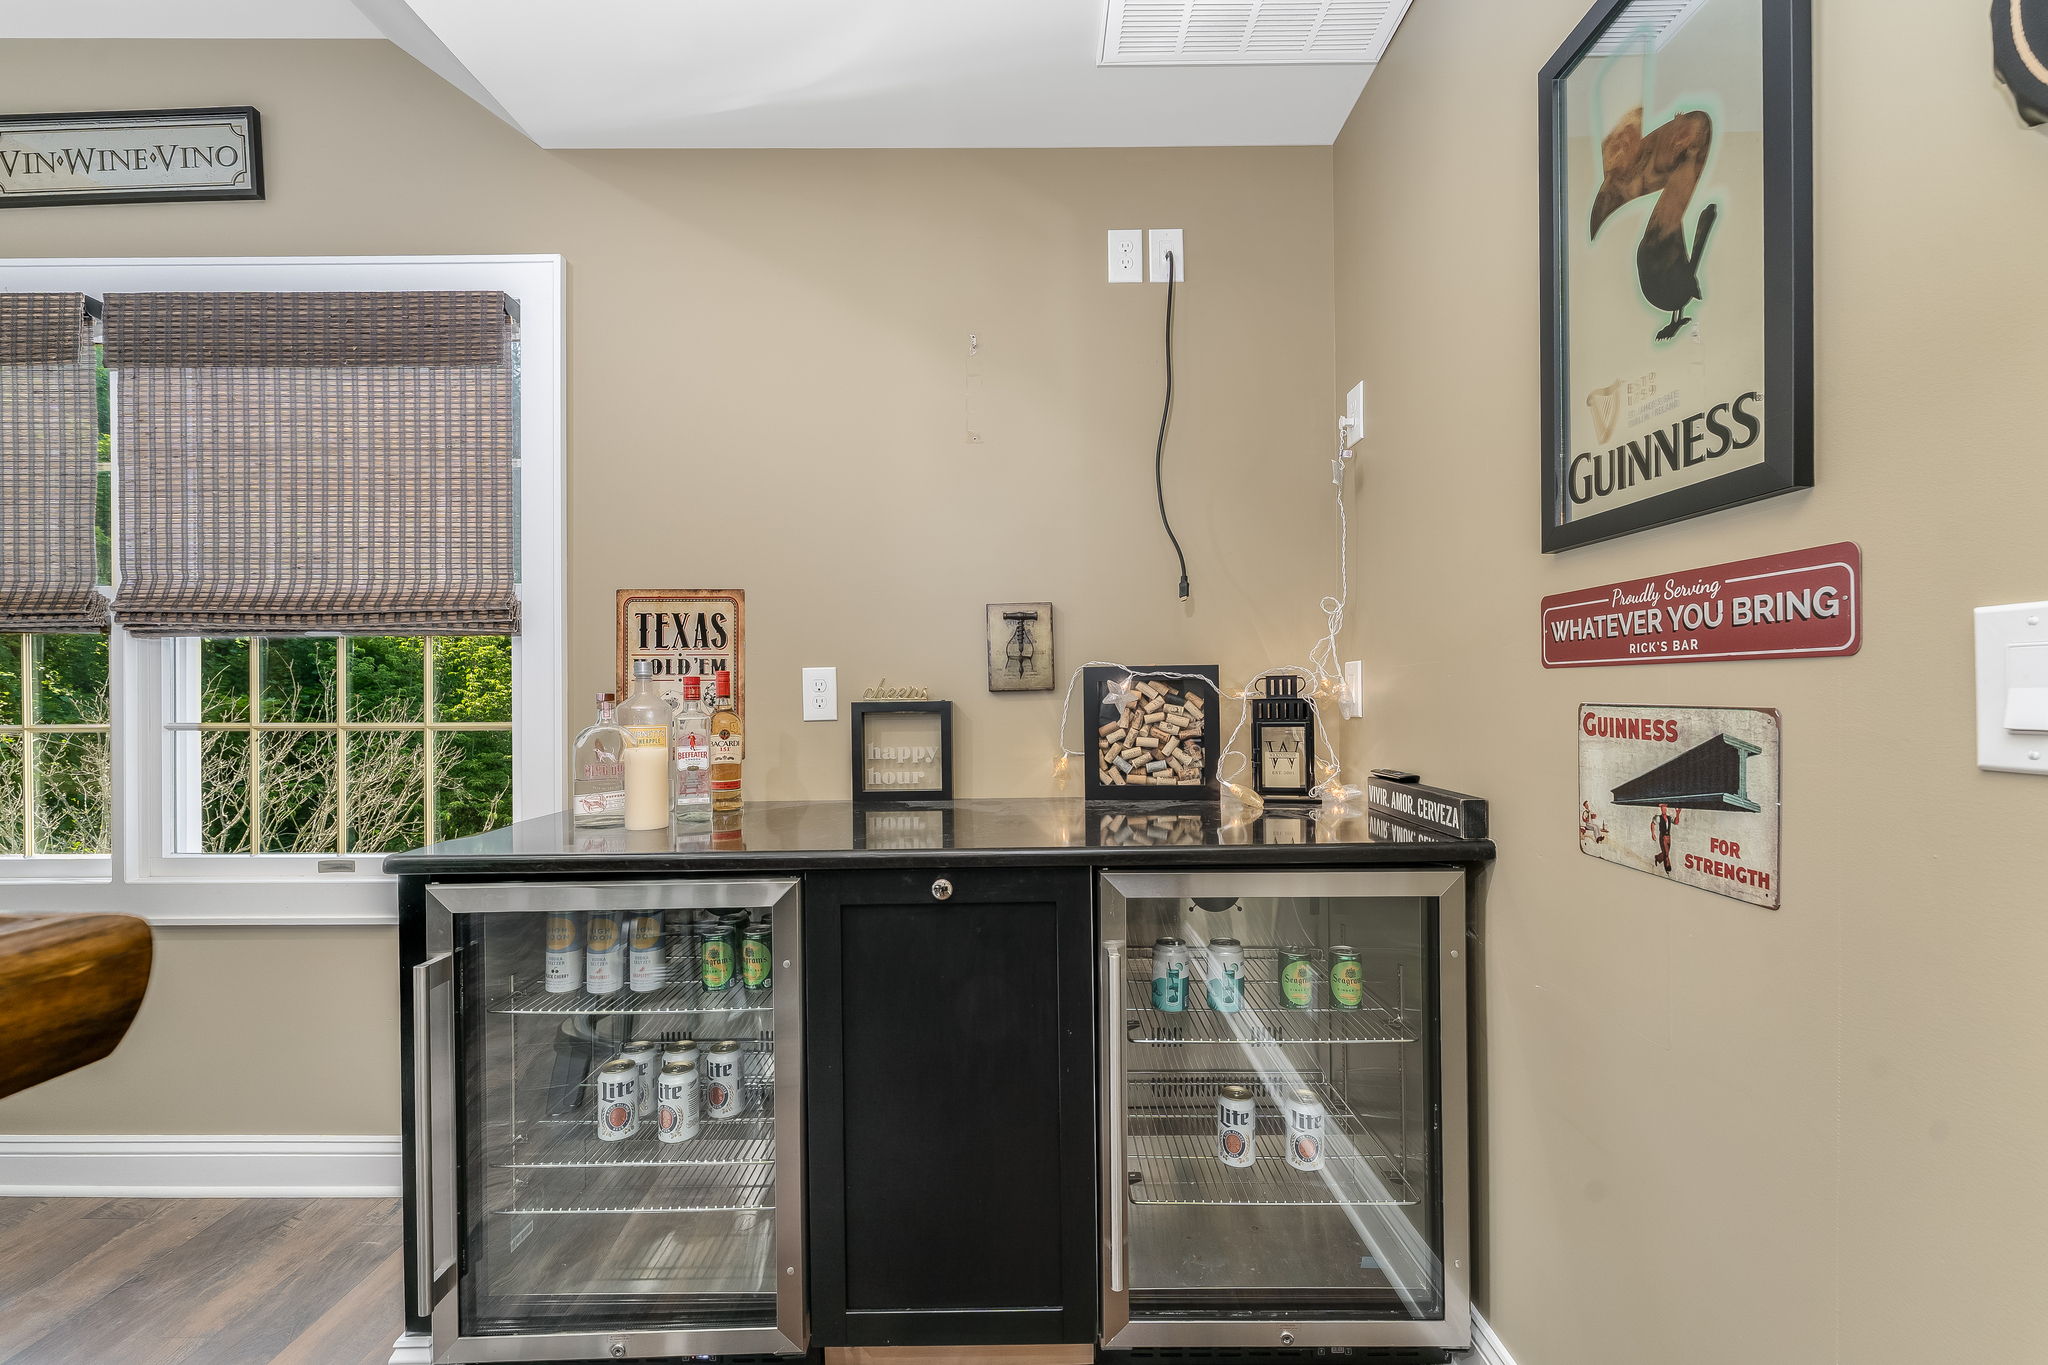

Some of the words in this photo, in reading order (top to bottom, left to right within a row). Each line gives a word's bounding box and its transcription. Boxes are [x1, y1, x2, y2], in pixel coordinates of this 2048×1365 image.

[0, 149, 56, 178] VIN
[61, 147, 149, 175] WINE
[153, 144, 239, 172] VINO
[1567, 391, 1761, 505] GUINNESS
[1611, 581, 1660, 608] Proudly
[1663, 578, 1721, 601] Serving
[1550, 607, 1663, 643] WHATEVER
[1666, 599, 1724, 632] YOU
[1732, 585, 1841, 627] BRING
[634, 612, 728, 650] TEXAS
[1628, 640, 1668, 655] RICK'S
[1672, 638, 1699, 652] BAR
[863, 677, 928, 700] cheers
[1582, 711, 1679, 743] GUINNESS
[677, 751, 708, 760] BEEFEATER
[866, 742, 940, 764] happy
[866, 767, 925, 785] hour
[1368, 784, 1390, 808] VIVIR.
[1391, 791, 1416, 816] AMOR.
[1417, 797, 1460, 830] CERVEZA
[1710, 837, 1741, 860] FOR
[1684, 853, 1770, 891] STRENGTH
[601, 1080, 635, 1103] Lite
[1220, 1104, 1250, 1128] Lite
[1291, 1109, 1322, 1133] Lite
